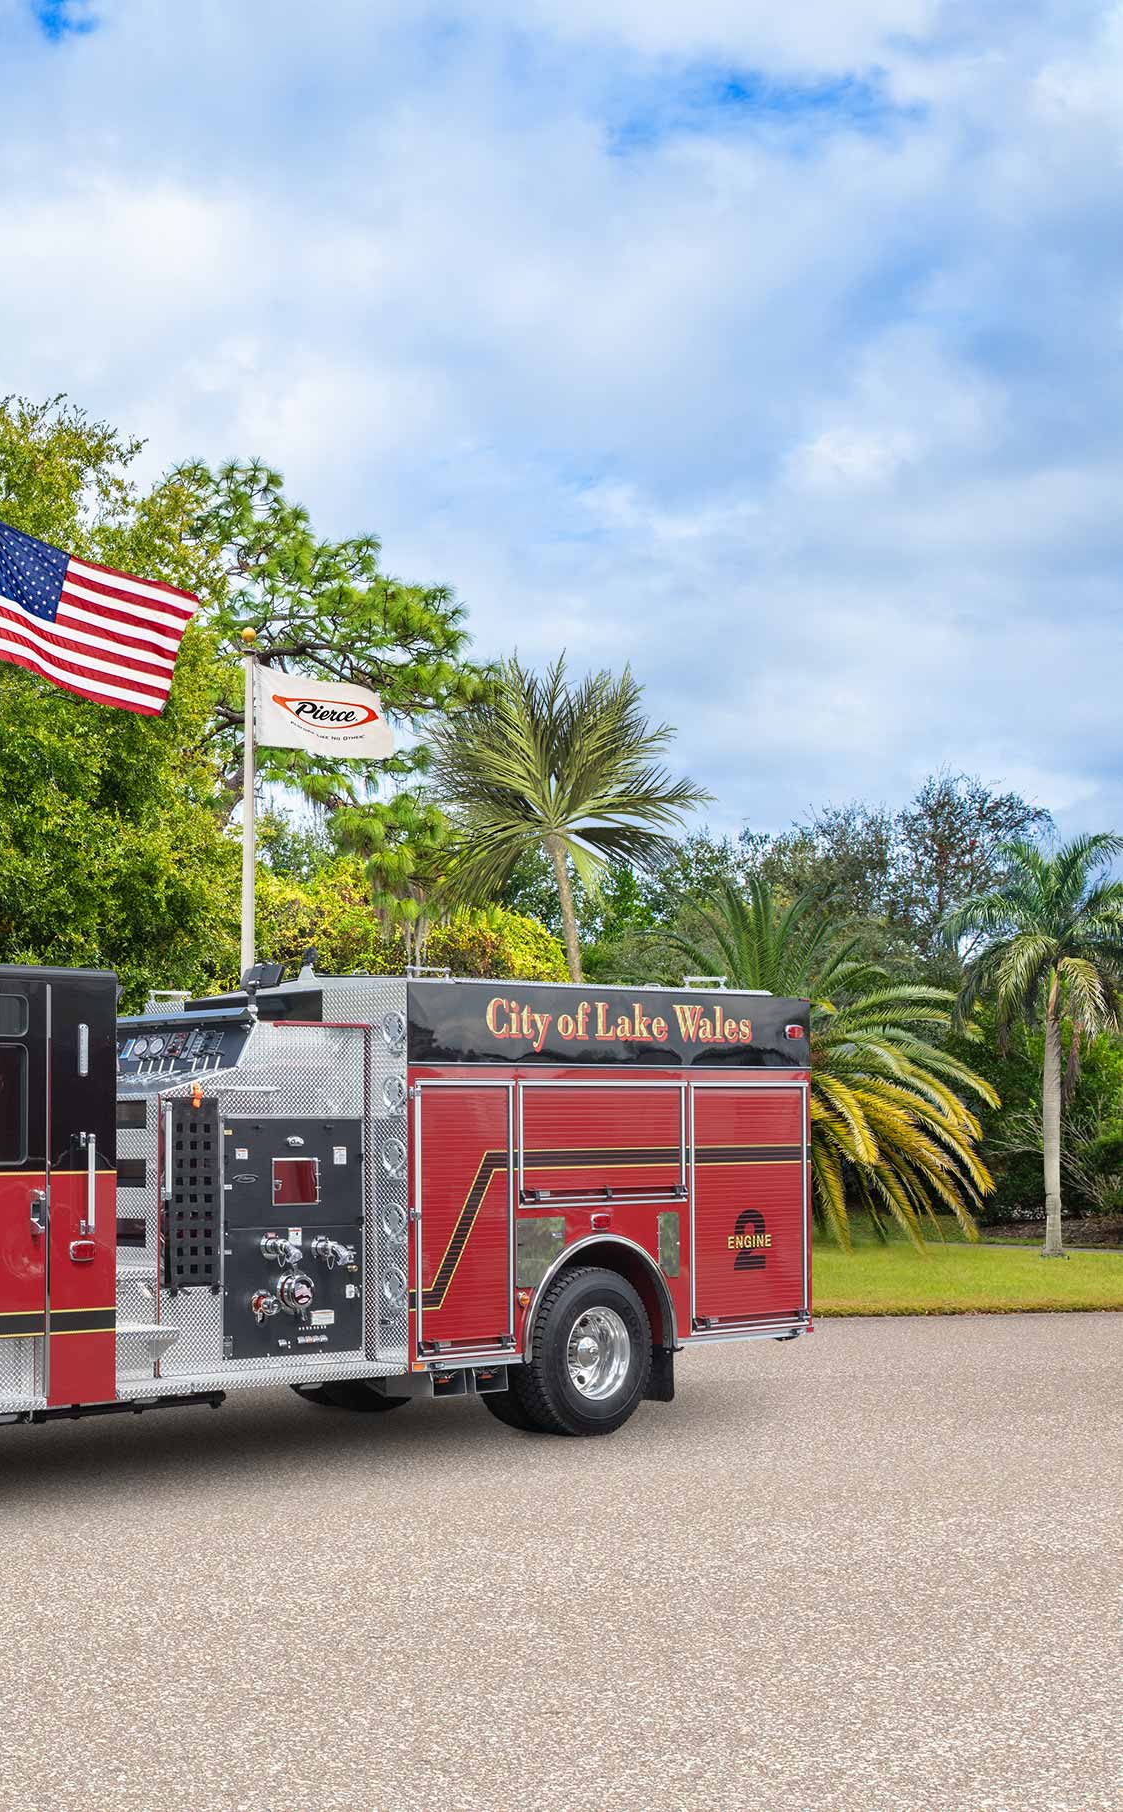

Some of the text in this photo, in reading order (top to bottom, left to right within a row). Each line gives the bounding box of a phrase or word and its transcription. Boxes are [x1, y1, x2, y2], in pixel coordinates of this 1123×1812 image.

[295, 702, 356, 722] Pierce
[486, 998, 753, 1053] City of Lake Wales
[727, 1234, 772, 1250] ENGINE
[734, 1208, 766, 1272] 2
